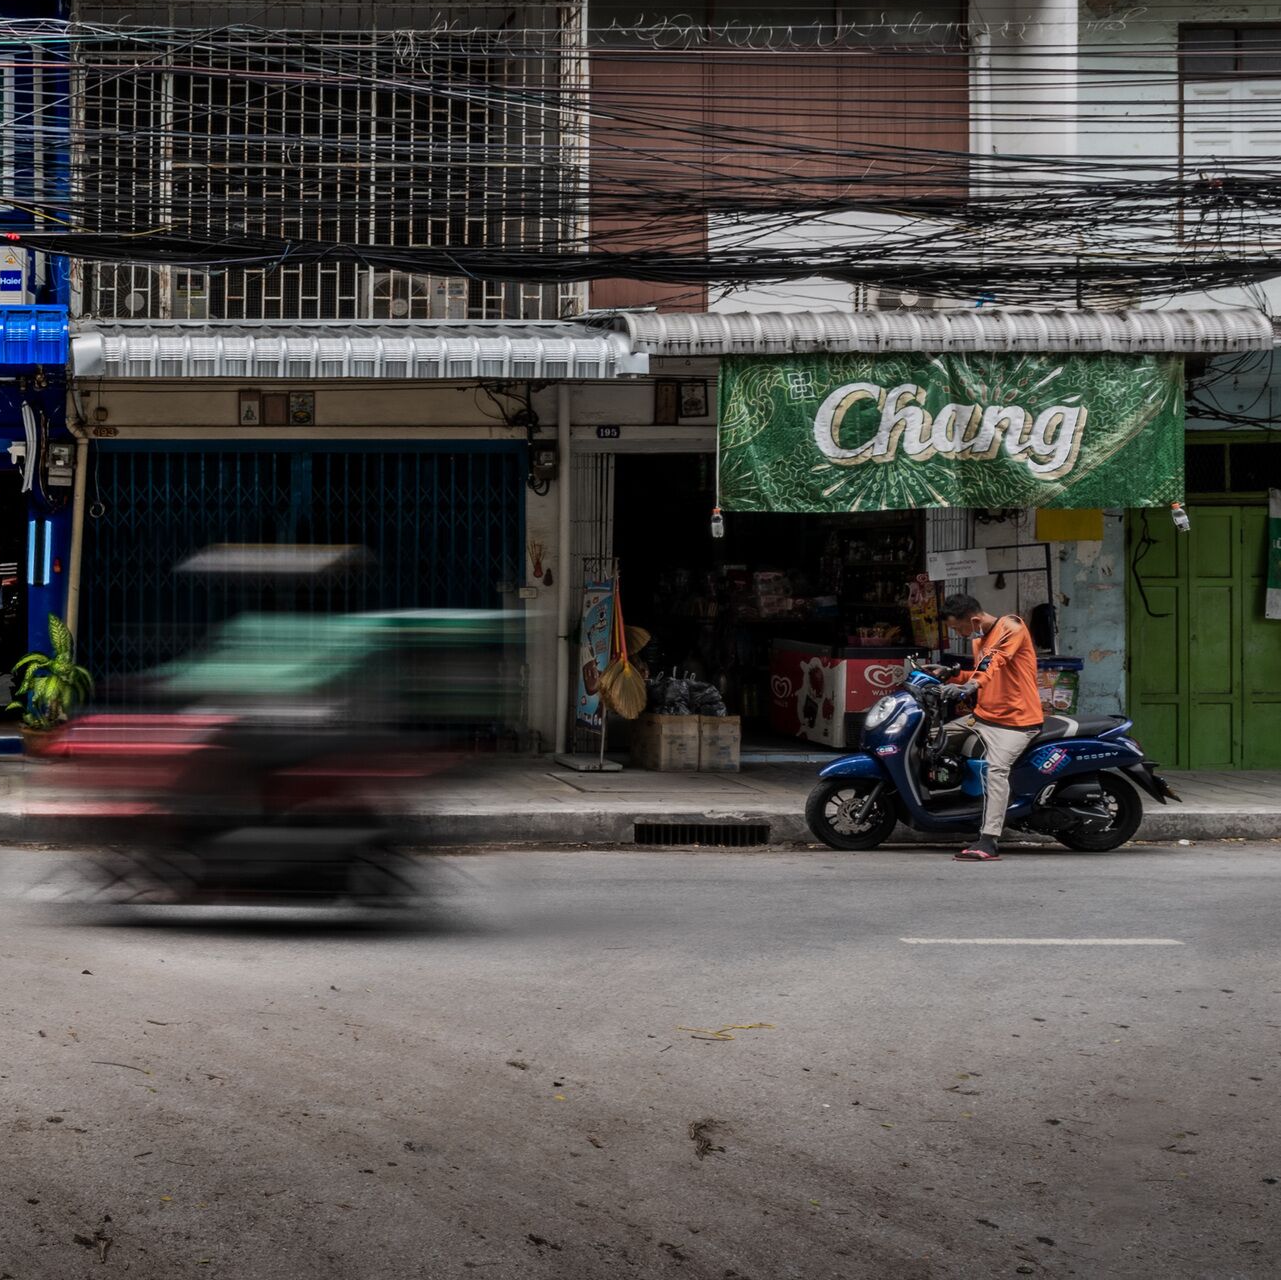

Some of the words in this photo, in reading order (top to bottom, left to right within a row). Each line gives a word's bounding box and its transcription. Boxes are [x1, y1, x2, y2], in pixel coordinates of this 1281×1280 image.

[0, 277, 21, 285] Haier
[599, 427, 618, 437] 195
[813, 382, 1089, 480] Chang
